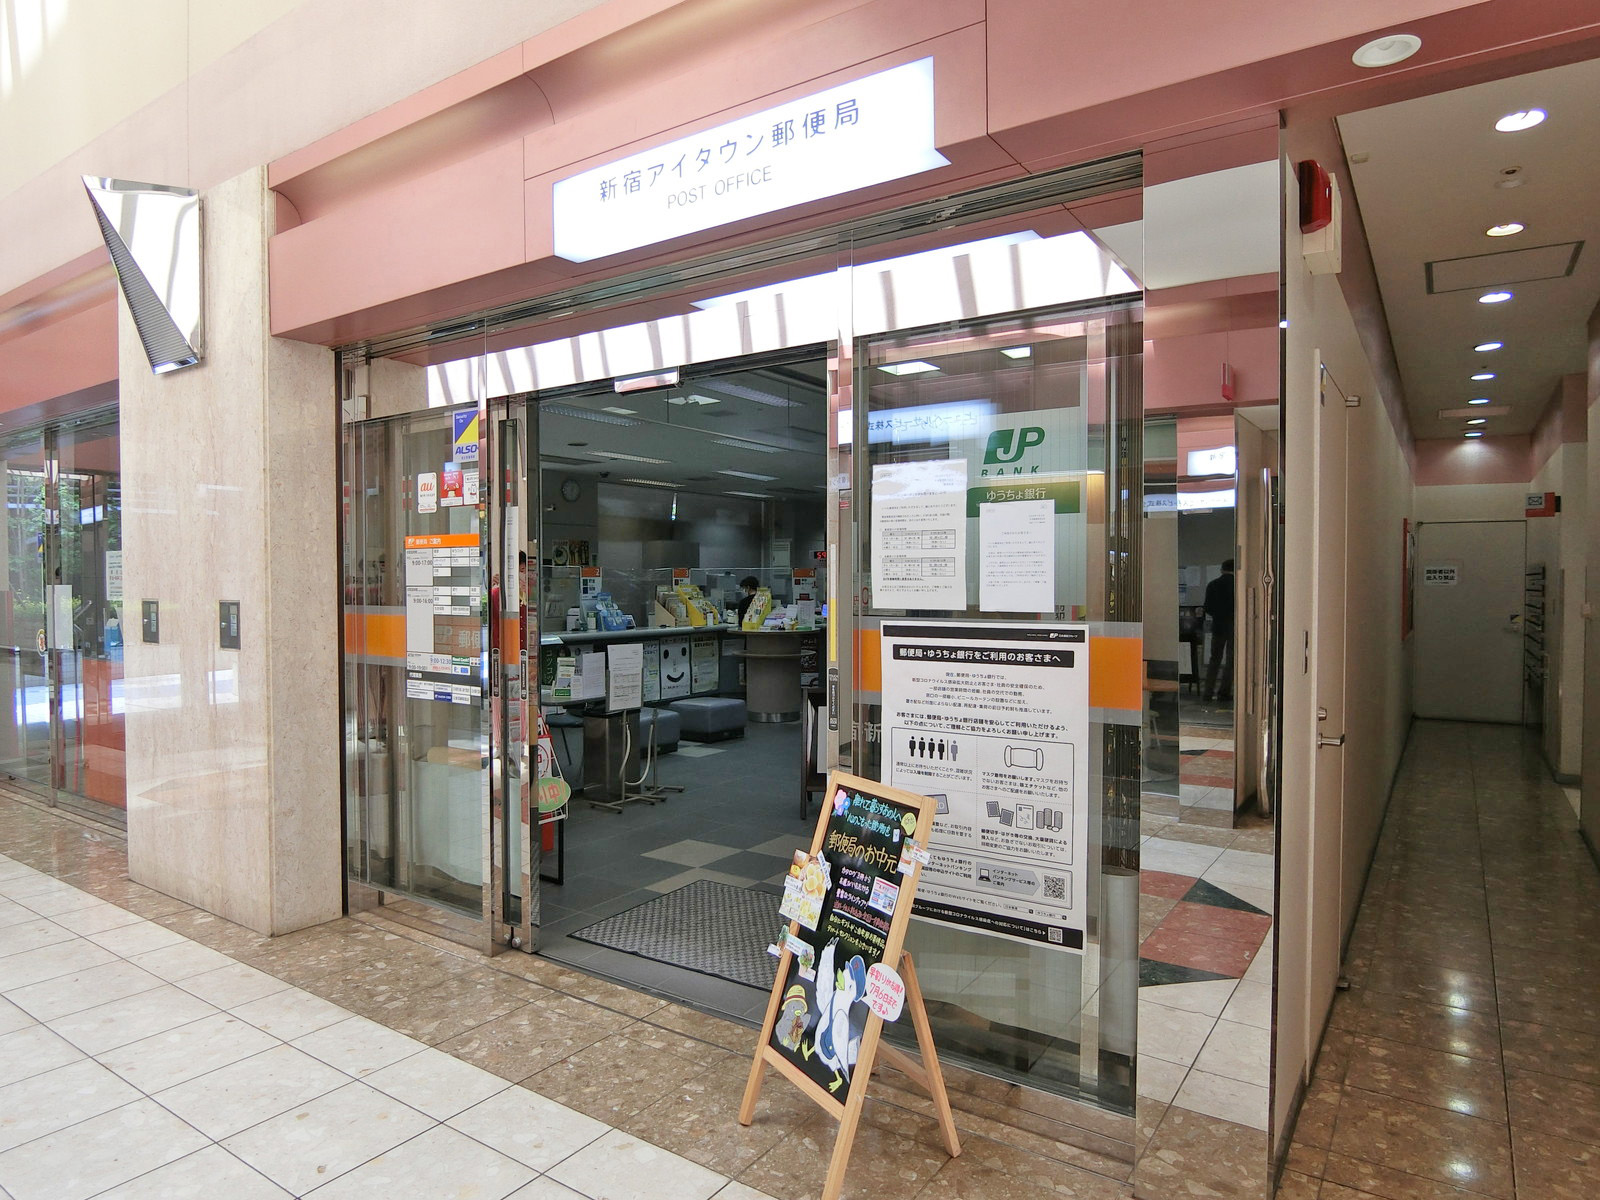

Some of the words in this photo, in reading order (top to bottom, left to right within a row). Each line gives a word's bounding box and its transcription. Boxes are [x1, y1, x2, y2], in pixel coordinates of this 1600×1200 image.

[598, 98, 861, 202] 新宿アイタウン郵便局
[666, 185, 706, 210] POST
[714, 164, 772, 197] OFFICE
[455, 444, 478, 455] ALSO
[983, 426, 1046, 464] JP
[981, 465, 1040, 477] BANK
[420, 482, 435, 492] au
[986, 487, 1046, 501] ゆうちょ銀行
[899, 648, 1061, 663] 郵便局・ゆうちょ銀行をご利用のお客さまへ
[828, 829, 897, 874] 郵便局のお中元
[869, 982, 898, 1009] 7月6日まで
